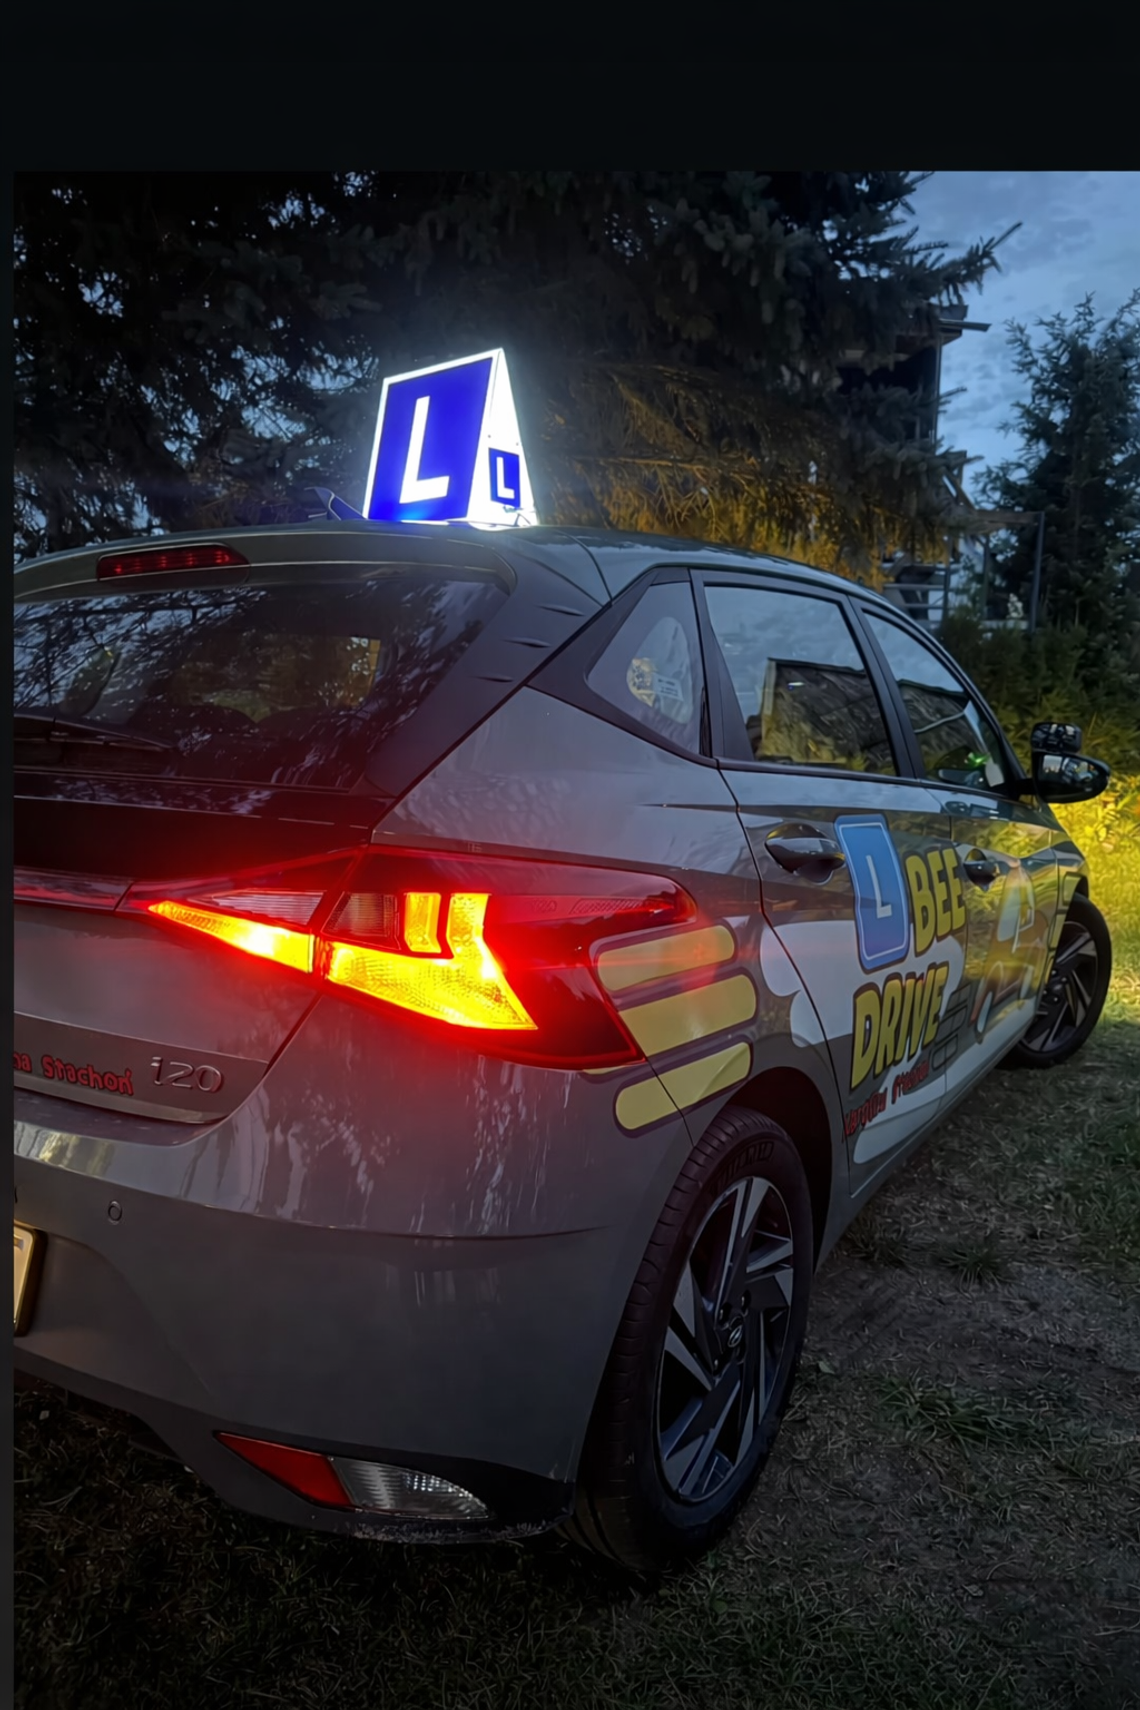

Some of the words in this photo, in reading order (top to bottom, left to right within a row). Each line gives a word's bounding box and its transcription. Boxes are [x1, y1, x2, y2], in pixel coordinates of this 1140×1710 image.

[400, 396, 449, 504] L
[497, 457, 514, 499] L
[867, 856, 892, 918] L
[906, 848, 966, 955] BEE
[851, 962, 950, 1091] DRIVE
[151, 1056, 223, 1093] i20
